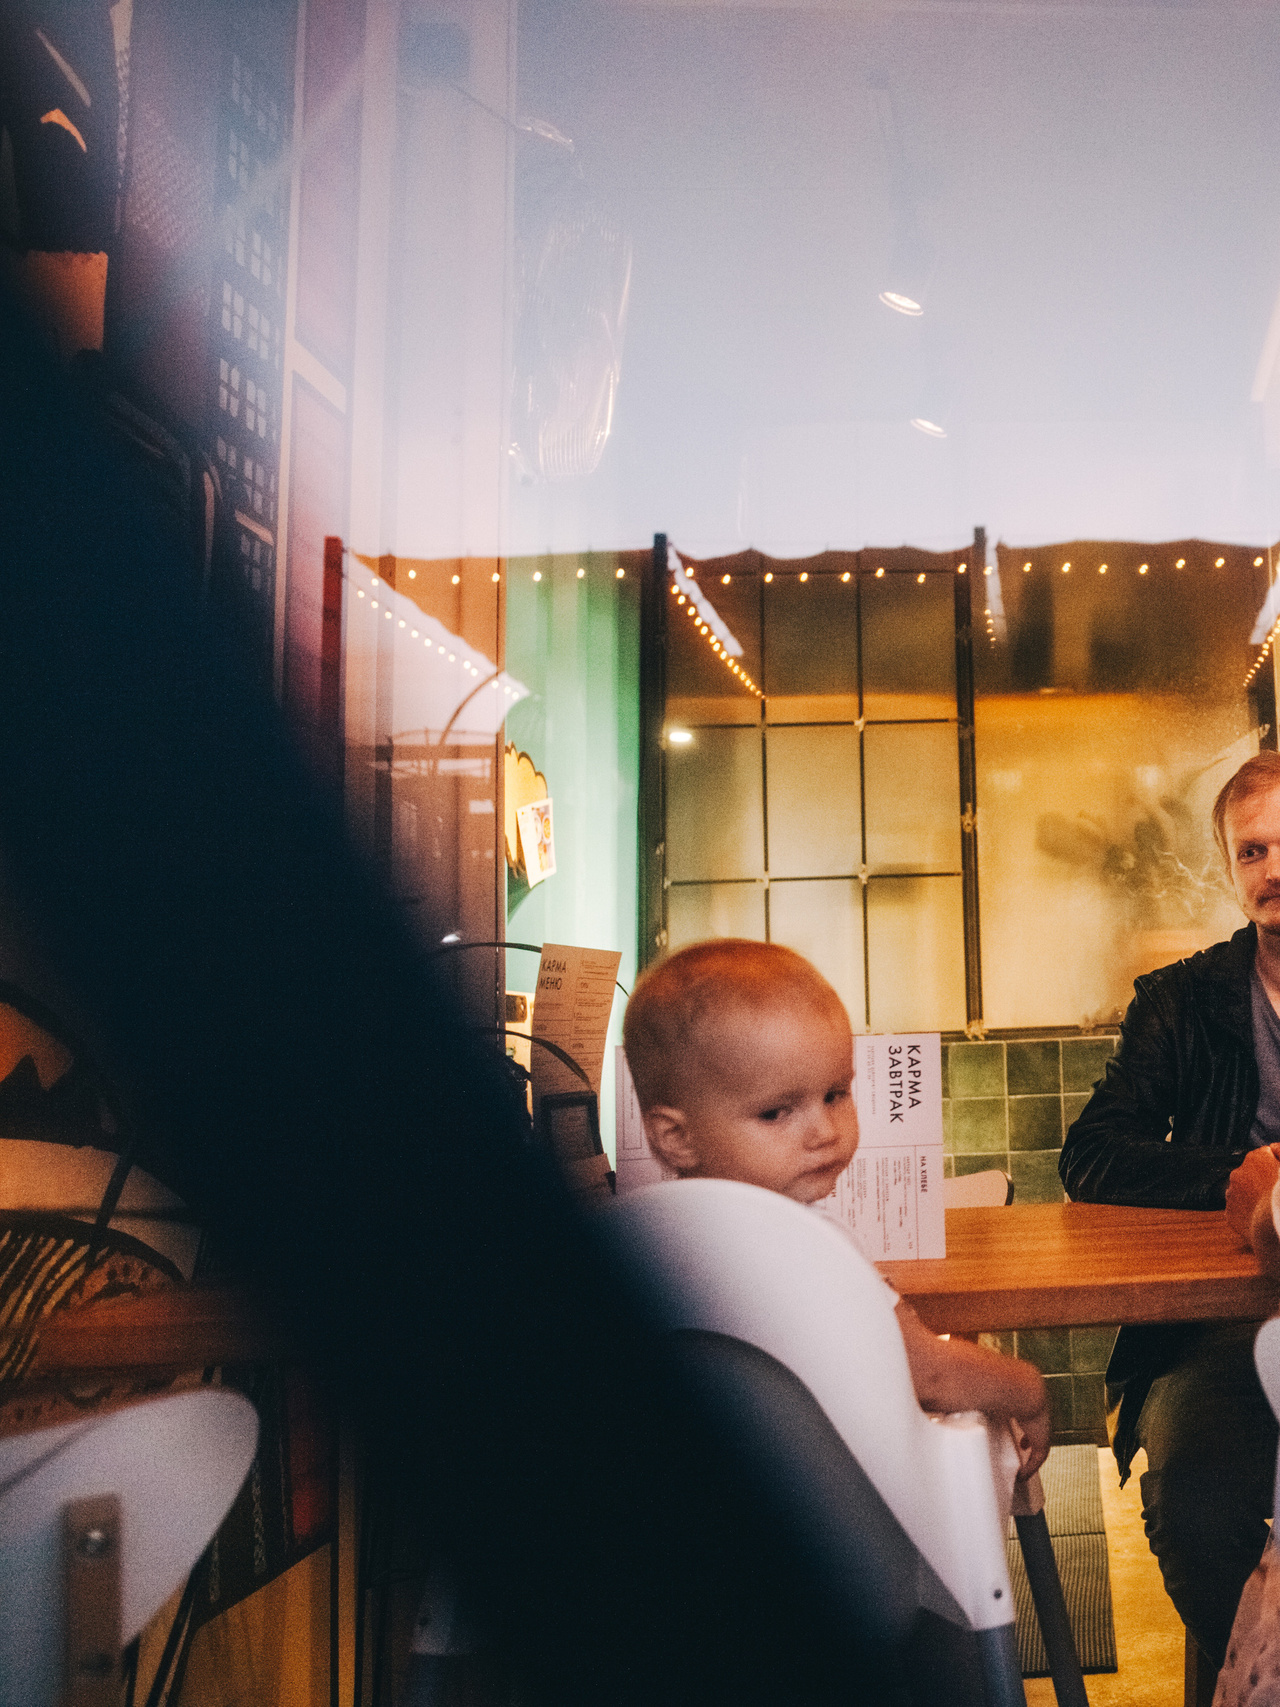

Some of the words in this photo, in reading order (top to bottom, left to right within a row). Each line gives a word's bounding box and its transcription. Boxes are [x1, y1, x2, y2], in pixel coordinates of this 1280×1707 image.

[541, 958, 567, 973] КАРМА
[539, 975, 563, 990] МЕНЮ
[888, 1045, 904, 1123] ЗАВТРАК
[907, 1044, 922, 1109] КАРМА
[920, 1155, 927, 1167] НА
